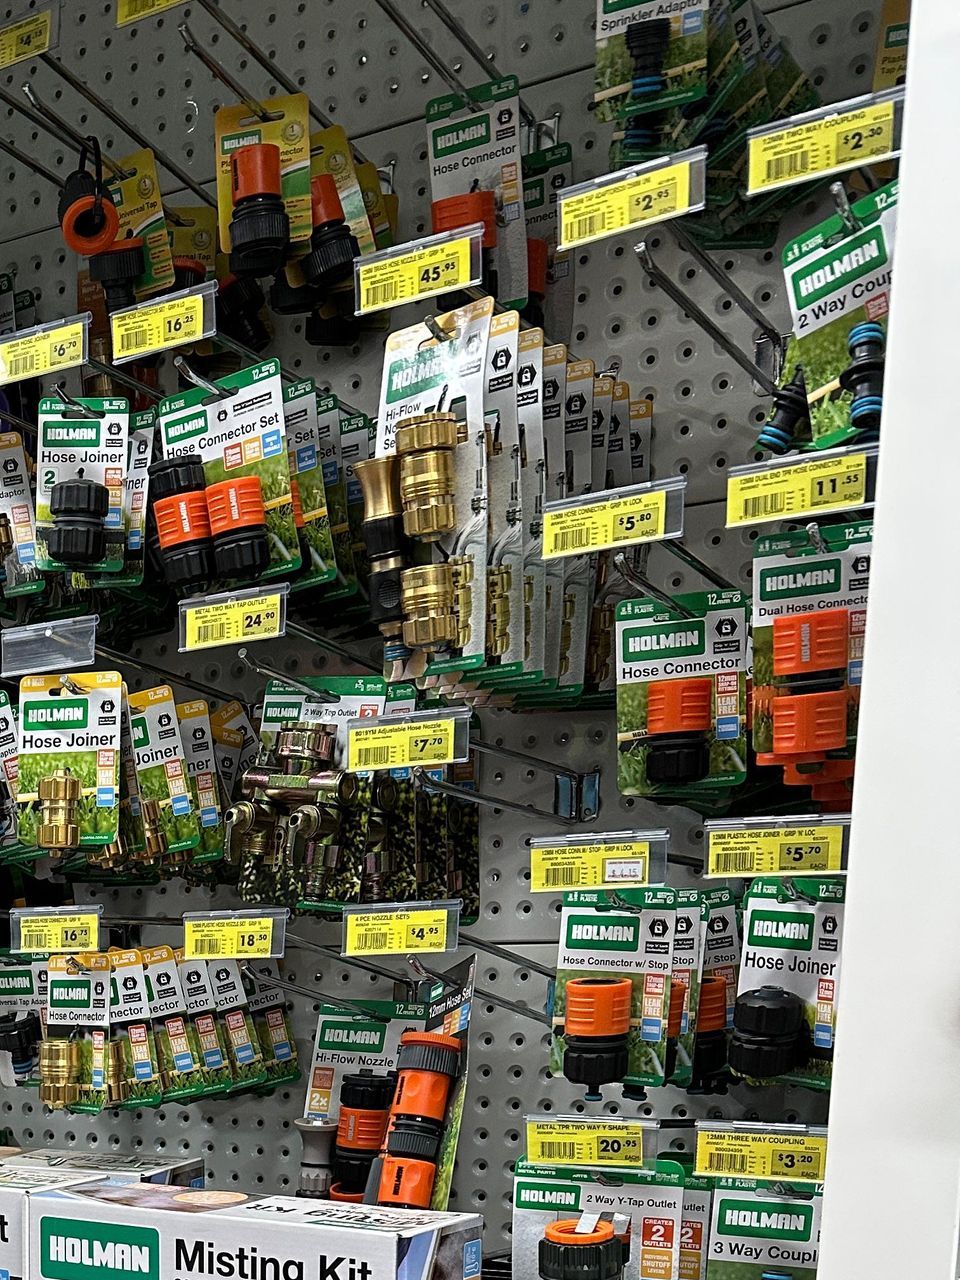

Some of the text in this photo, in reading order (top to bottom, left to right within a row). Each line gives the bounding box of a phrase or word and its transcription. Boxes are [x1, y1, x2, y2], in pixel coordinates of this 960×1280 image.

[842, 126, 884, 152] $2.30
[433, 144, 516, 176] Hose Connector
[634, 188, 670, 212] $2.95
[421, 261, 456, 284] 45.95
[799, 239, 879, 297] HOLMAN
[799, 313, 808, 329] 2
[811, 293, 847, 322] Way
[166, 314, 194, 333] 16.25
[46, 424, 96, 442] HOLMAN
[166, 411, 279, 458] Hose Connector Set
[167, 415, 205, 438] HOLMAN
[41, 450, 123, 464] Hose Joiner
[618, 511, 652, 531] $5.80
[766, 569, 835, 592] HOLMAN
[247, 598, 267, 607] OUTLET
[245, 611, 275, 628] 24.90
[628, 631, 699, 652] HOLMAN
[621, 656, 741, 680] Hose Connector
[28, 708, 84, 724] HOLMAN
[267, 706, 298, 719] HOLMAN
[22, 733, 116, 749] Hose Joiner
[414, 737, 442, 753] $7.70
[786, 844, 821, 862] $5.70
[63, 929, 88, 941] 16.75
[411, 927, 438, 941] $4.95
[571, 924, 634, 942] HOLMAN
[753, 920, 808, 940] HOLMAN
[239, 933, 268, 947] 18.50
[744, 952, 836, 977] Hose Joiner
[52, 986, 88, 1002] HOLMAN
[49, 1010, 105, 1022] Hose Connector
[324, 1028, 380, 1046] HOLMAN
[316, 1052, 394, 1067] Hi-Flow Nozzle
[586, 1124, 601, 1132] WAY
[600, 1138, 637, 1153] 20.95
[727, 1134, 749, 1142] THREE
[768, 1136, 805, 1145] COUPLING
[778, 1153, 812, 1168] $3.20
[521, 1189, 575, 1204] HOLMAN
[724, 1209, 805, 1230] HOLMAN
[48, 1235, 150, 1273] HOLMAN
